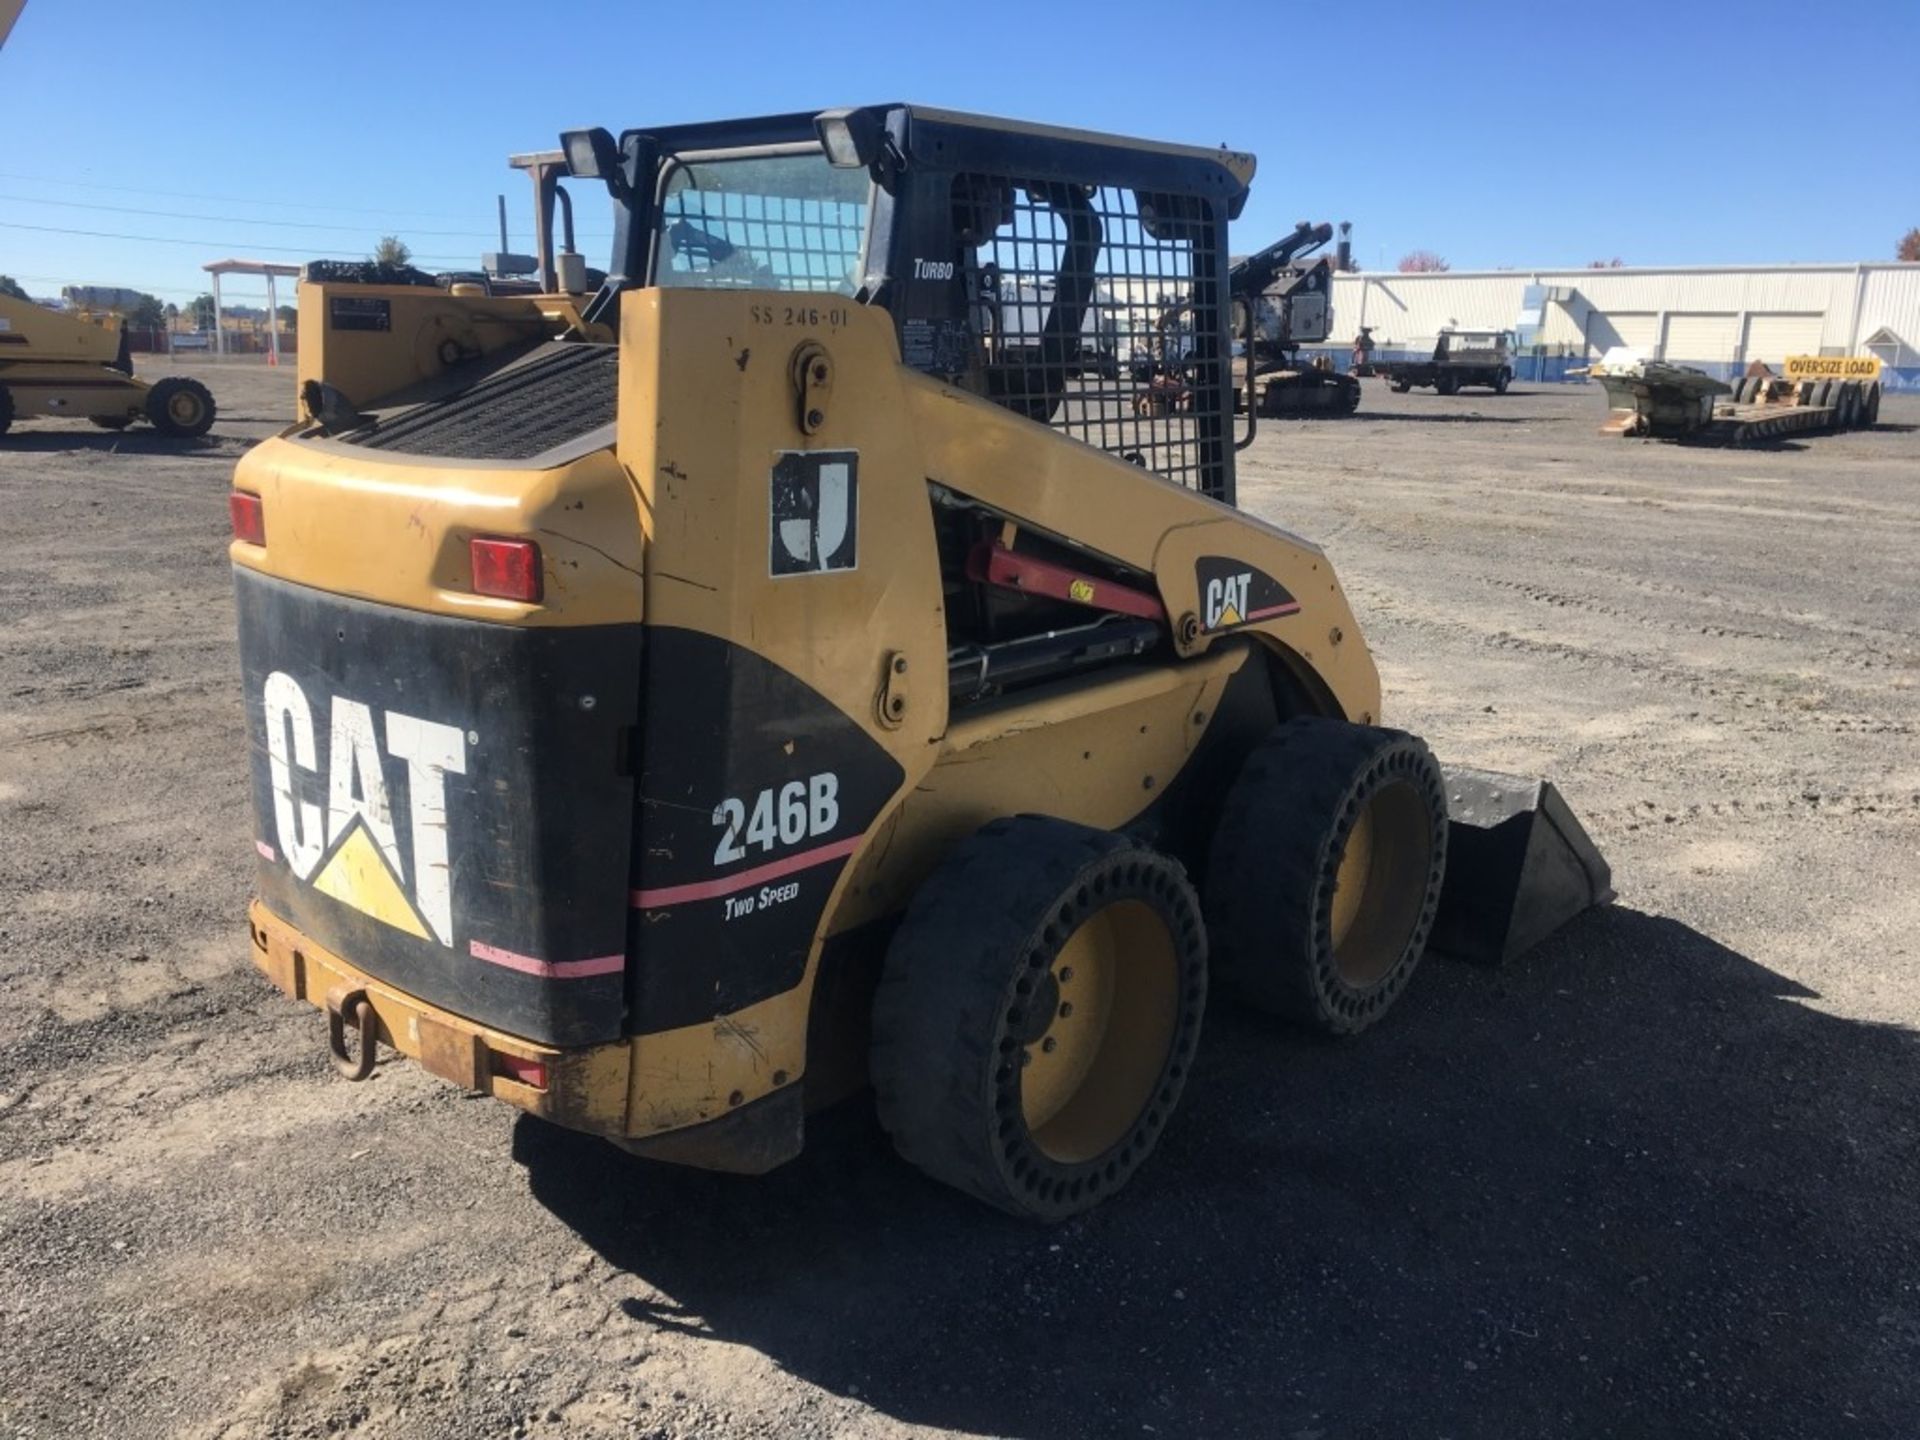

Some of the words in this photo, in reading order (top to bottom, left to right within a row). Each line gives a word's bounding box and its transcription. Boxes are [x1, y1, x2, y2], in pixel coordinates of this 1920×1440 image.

[914, 258, 953, 280] TURBO
[751, 305, 773, 324] SS
[1790, 360, 1841, 374] OVERSIZE
[1845, 361, 1875, 374] LOAD
[1206, 573, 1252, 629] CAT
[264, 671, 467, 948] CAT
[712, 772, 839, 866] 246B
[724, 896, 754, 921] TWO
[758, 882, 799, 911] SPEED
